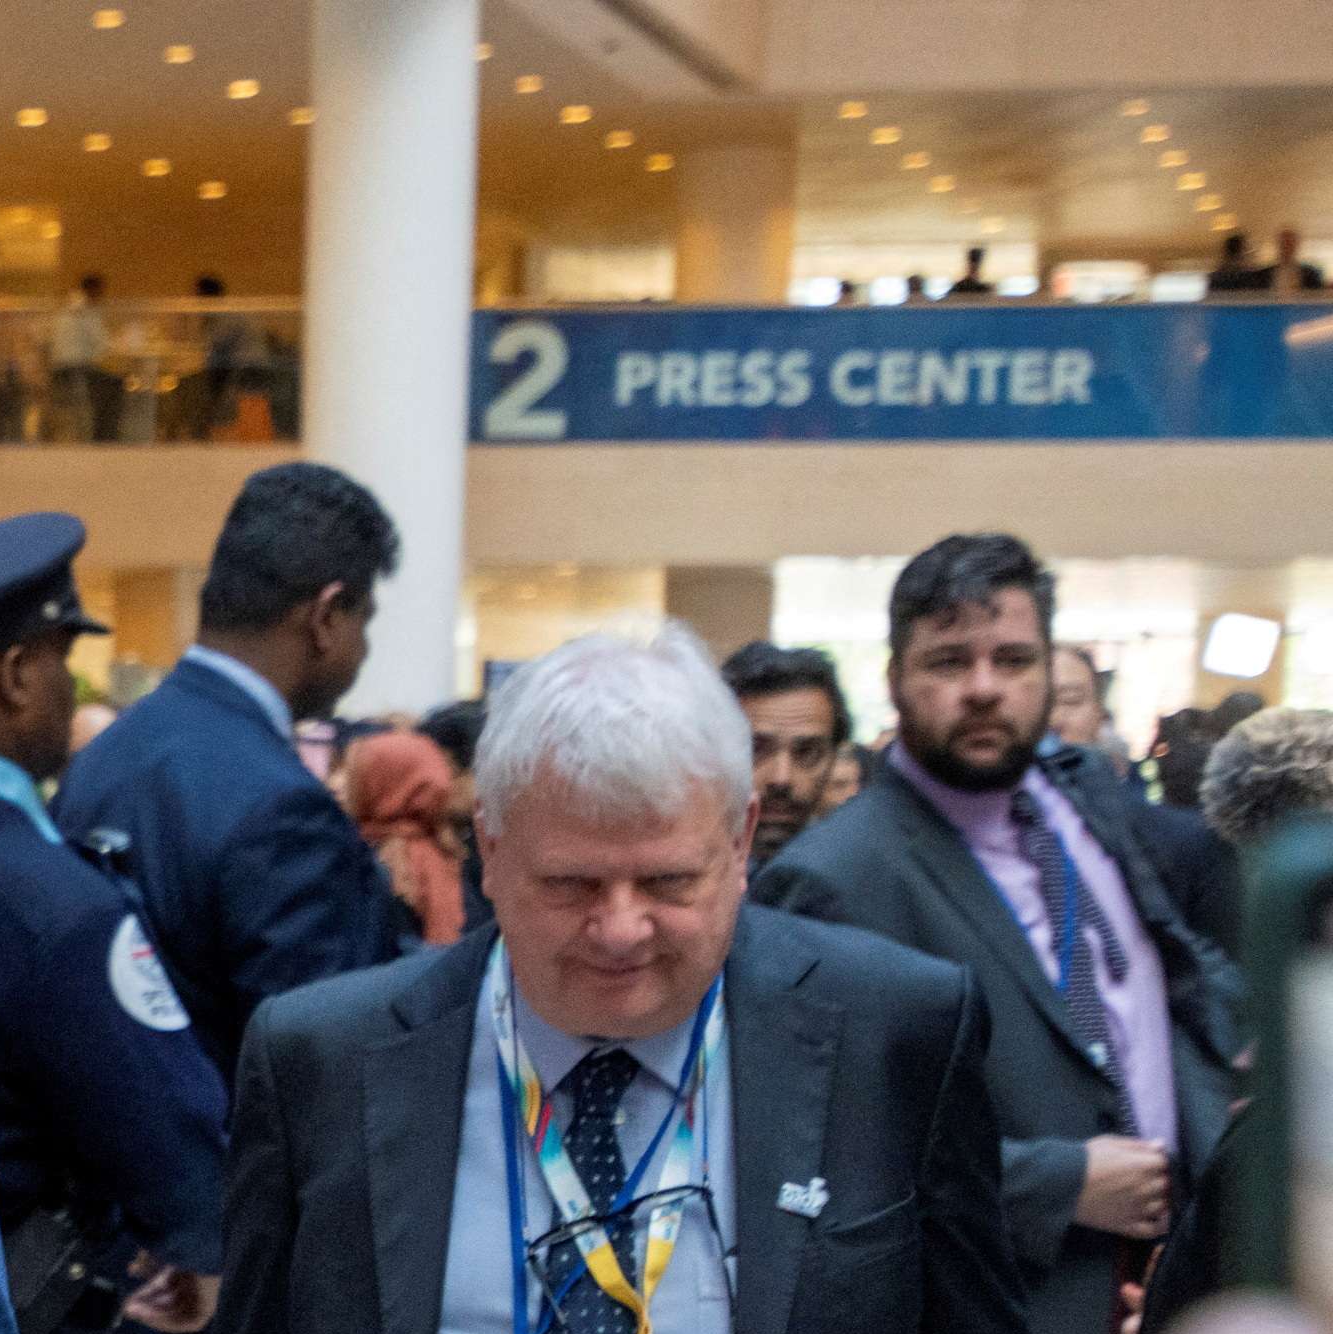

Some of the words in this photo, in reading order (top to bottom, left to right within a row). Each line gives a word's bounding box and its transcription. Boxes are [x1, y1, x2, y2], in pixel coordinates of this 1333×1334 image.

[485, 320, 568, 438] 2
[616, 350, 812, 407] PRESS
[830, 350, 1093, 406] CENTER
